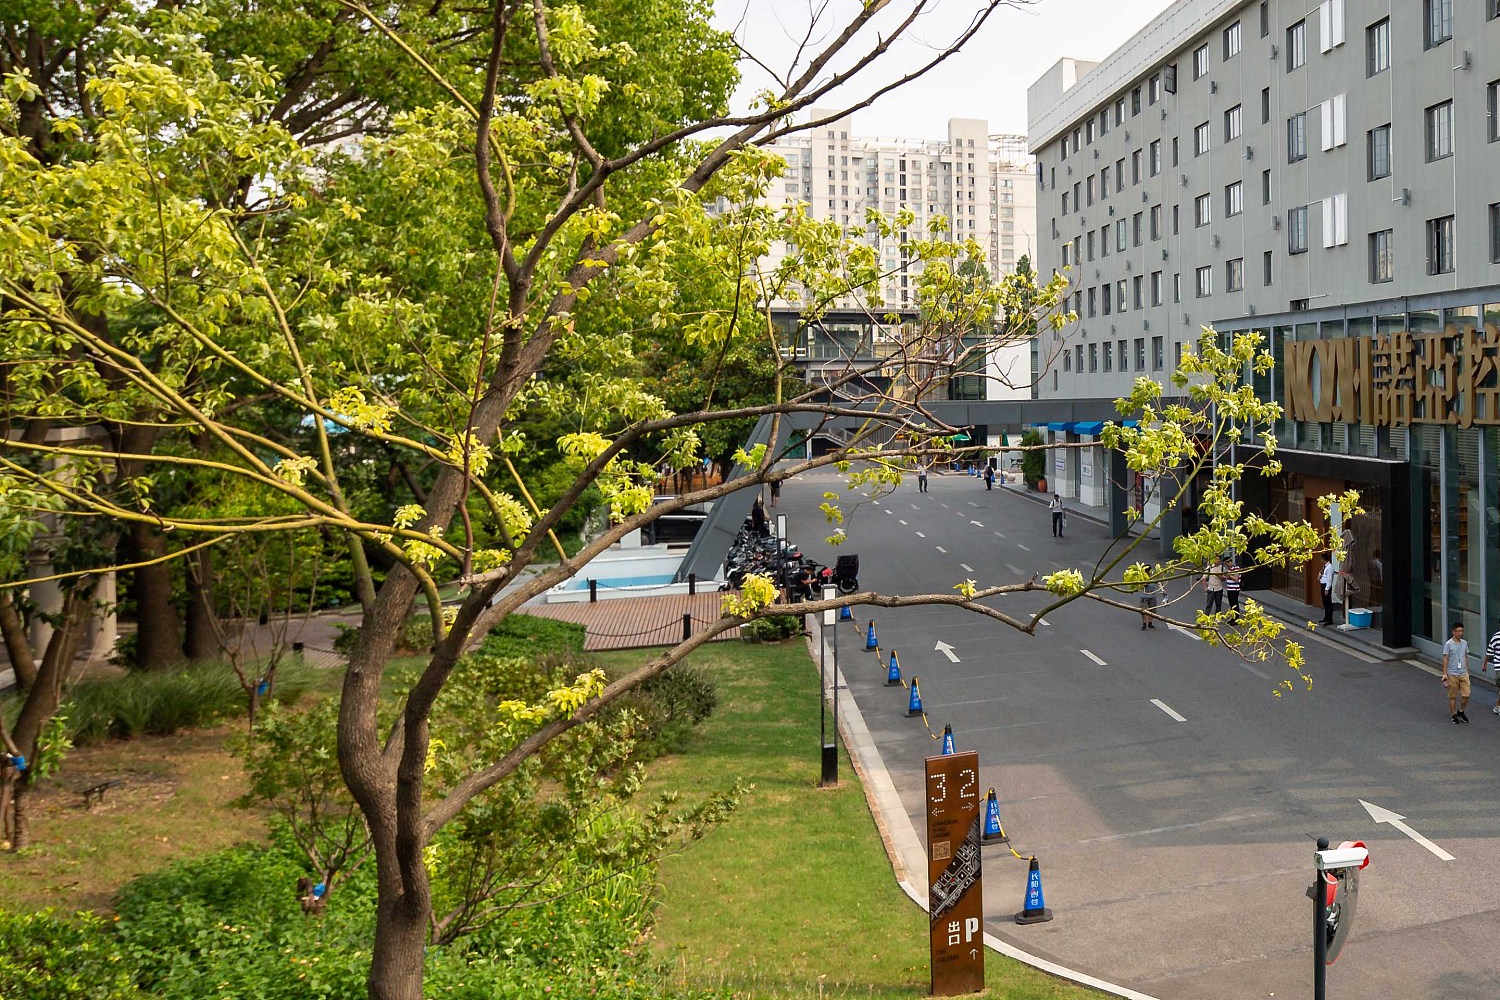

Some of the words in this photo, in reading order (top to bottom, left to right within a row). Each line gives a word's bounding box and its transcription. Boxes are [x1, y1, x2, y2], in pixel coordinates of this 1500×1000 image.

[931, 773, 946, 802] 3
[960, 769, 975, 798] 2
[948, 921, 961, 946] 出口
[965, 917, 979, 943] P
